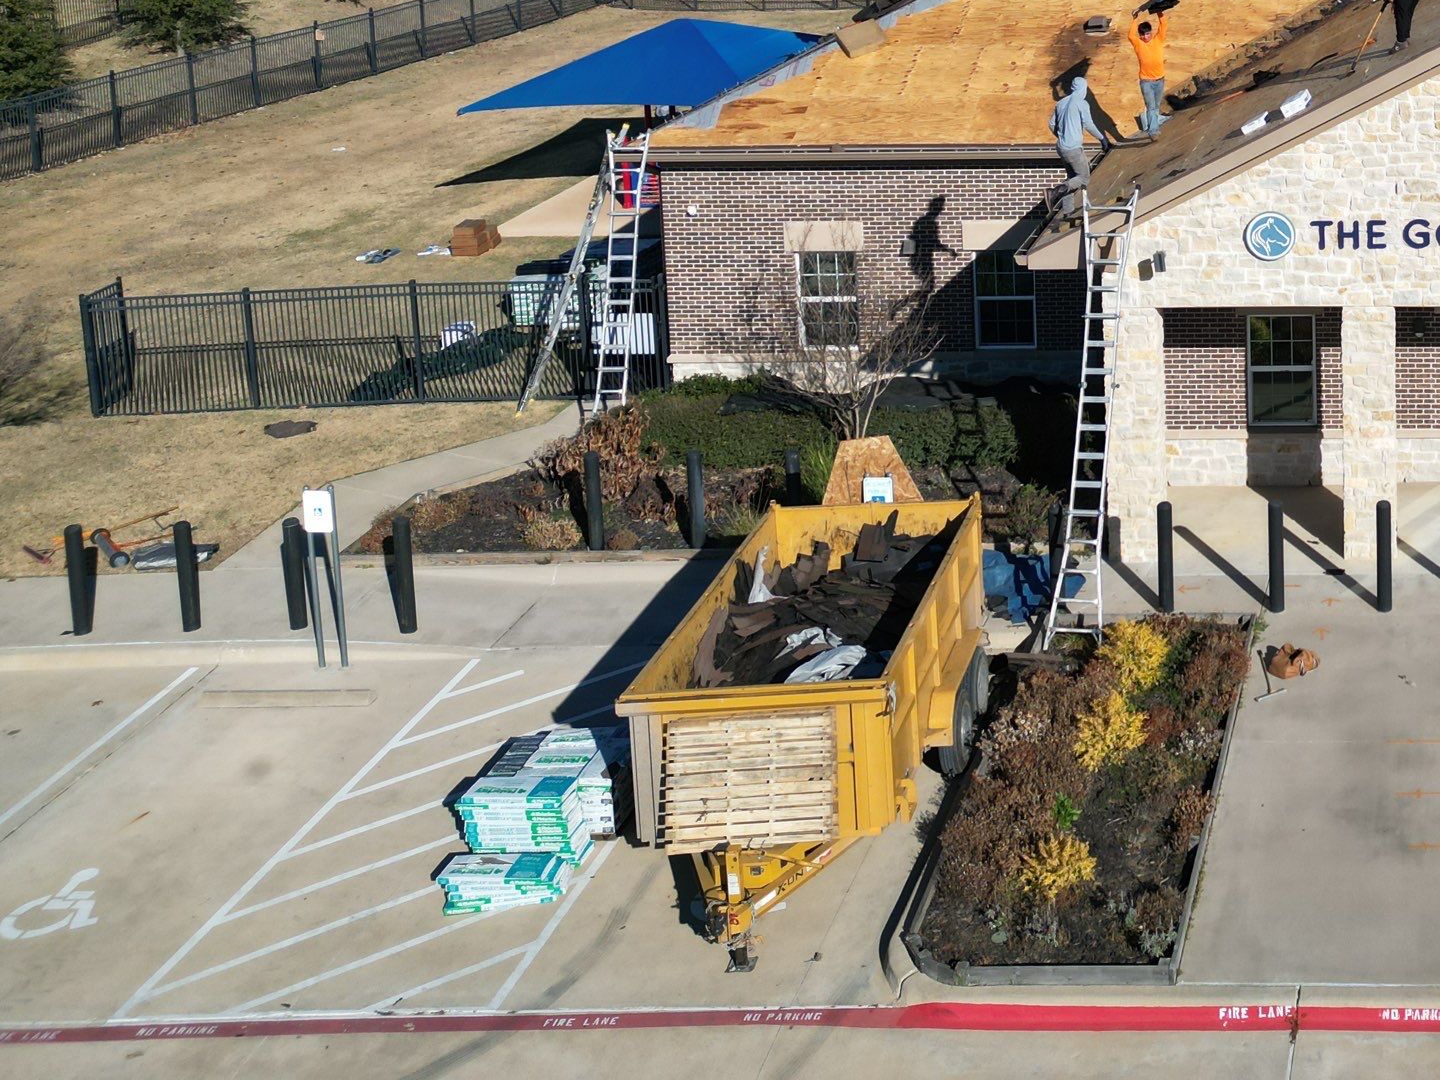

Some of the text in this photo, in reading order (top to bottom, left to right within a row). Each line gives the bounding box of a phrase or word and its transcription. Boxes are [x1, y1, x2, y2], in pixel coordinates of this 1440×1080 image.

[1309, 219, 1388, 251] THE
[743, 1011, 823, 1022] NO PARKING
[1219, 1005, 1293, 1020] FIRE LANE
[1381, 1008, 1400, 1021] NO
[543, 1015, 620, 1028] FIRE LANE
[135, 1025, 218, 1037] NO PARKING
